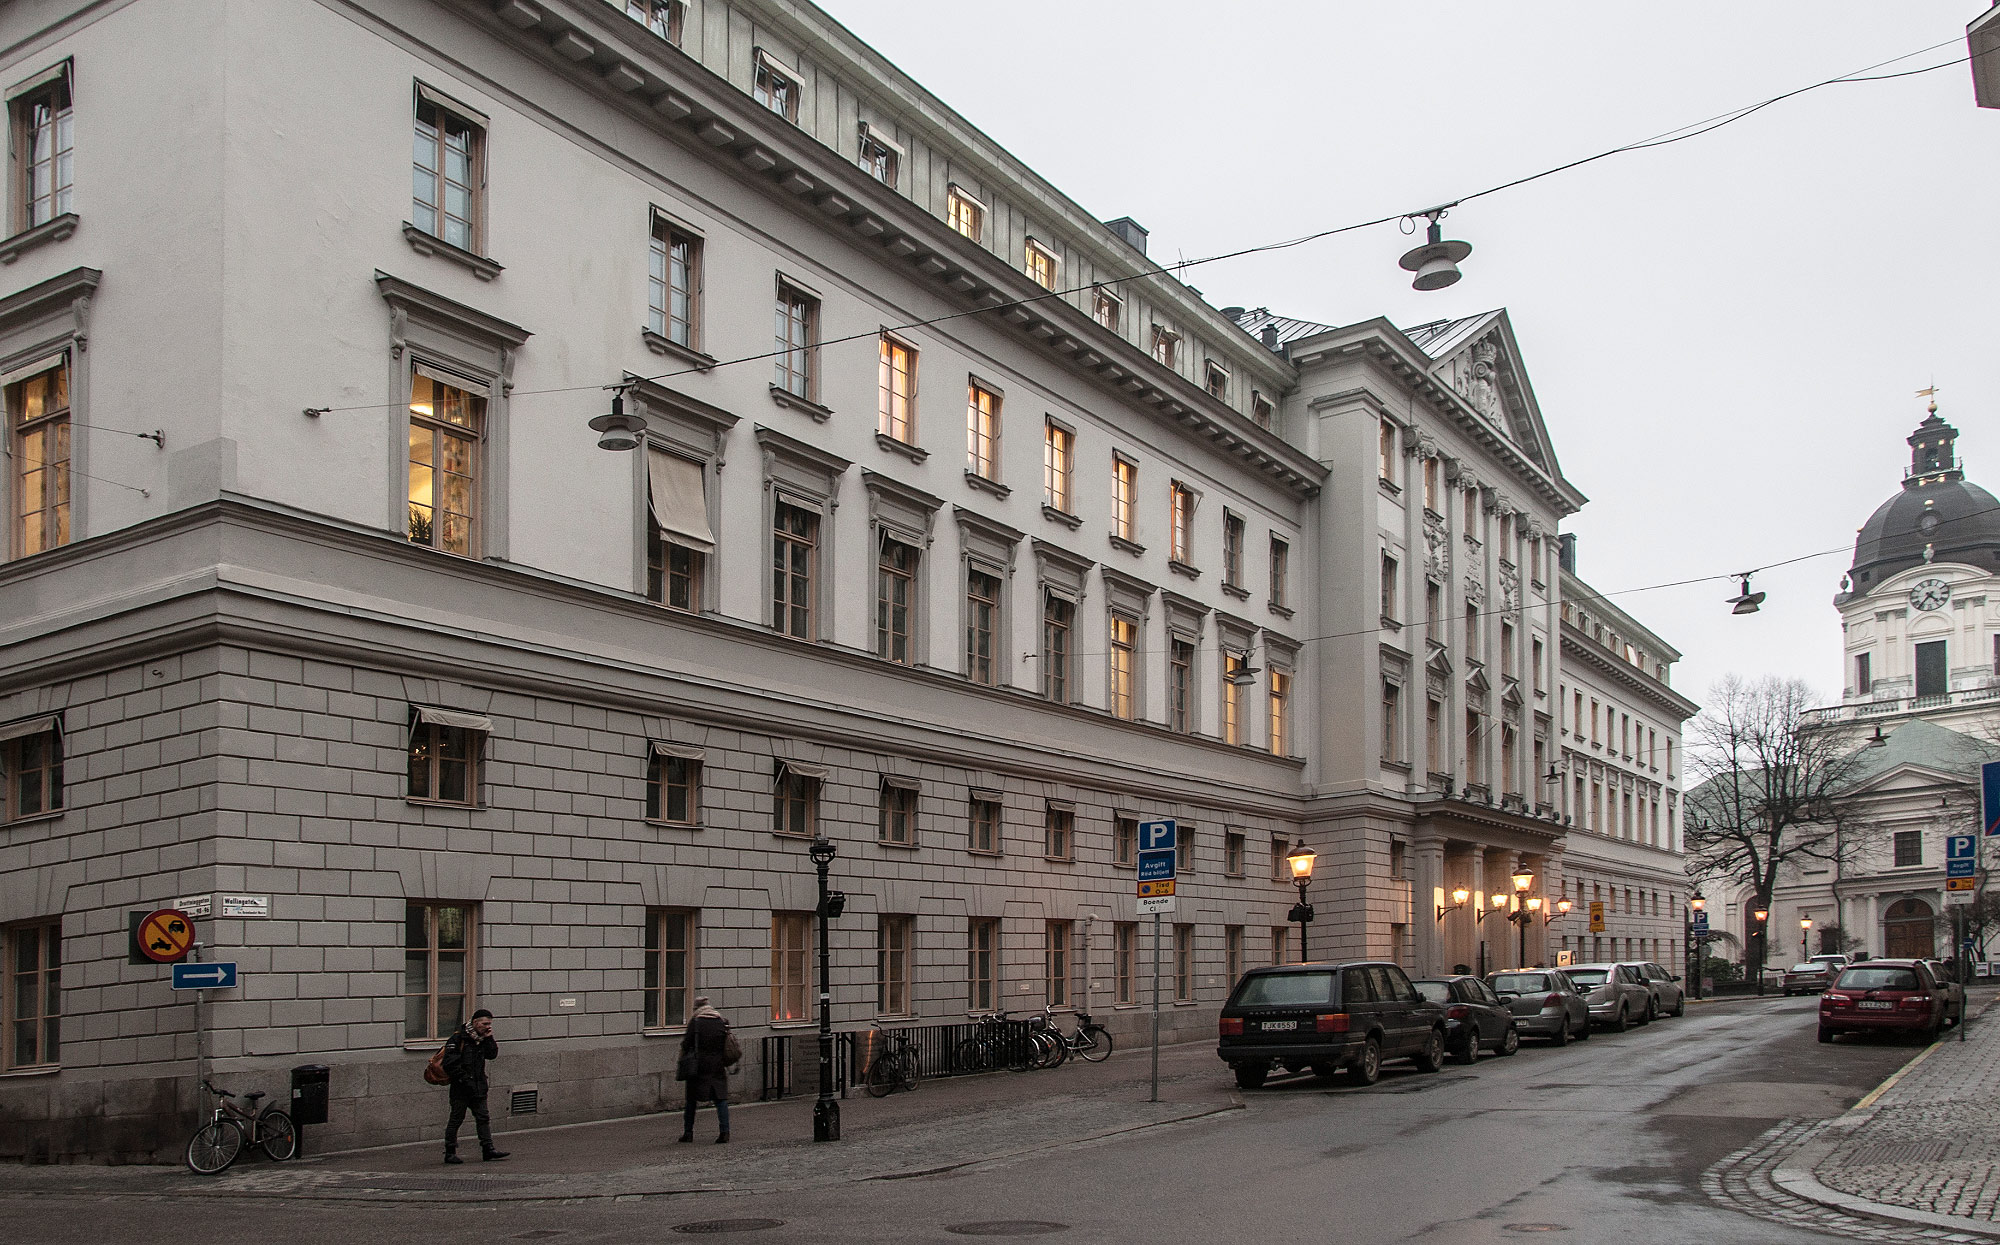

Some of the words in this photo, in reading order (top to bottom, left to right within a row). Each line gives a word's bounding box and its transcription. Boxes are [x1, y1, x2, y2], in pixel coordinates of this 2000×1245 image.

[1149, 823, 1168, 848] P
[1954, 837, 1970, 857] P
[1144, 861, 1166, 870] Avgift
[1143, 898, 1169, 906] Boende
[1697, 913, 1705, 923] P
[1560, 954, 1568, 962] P
